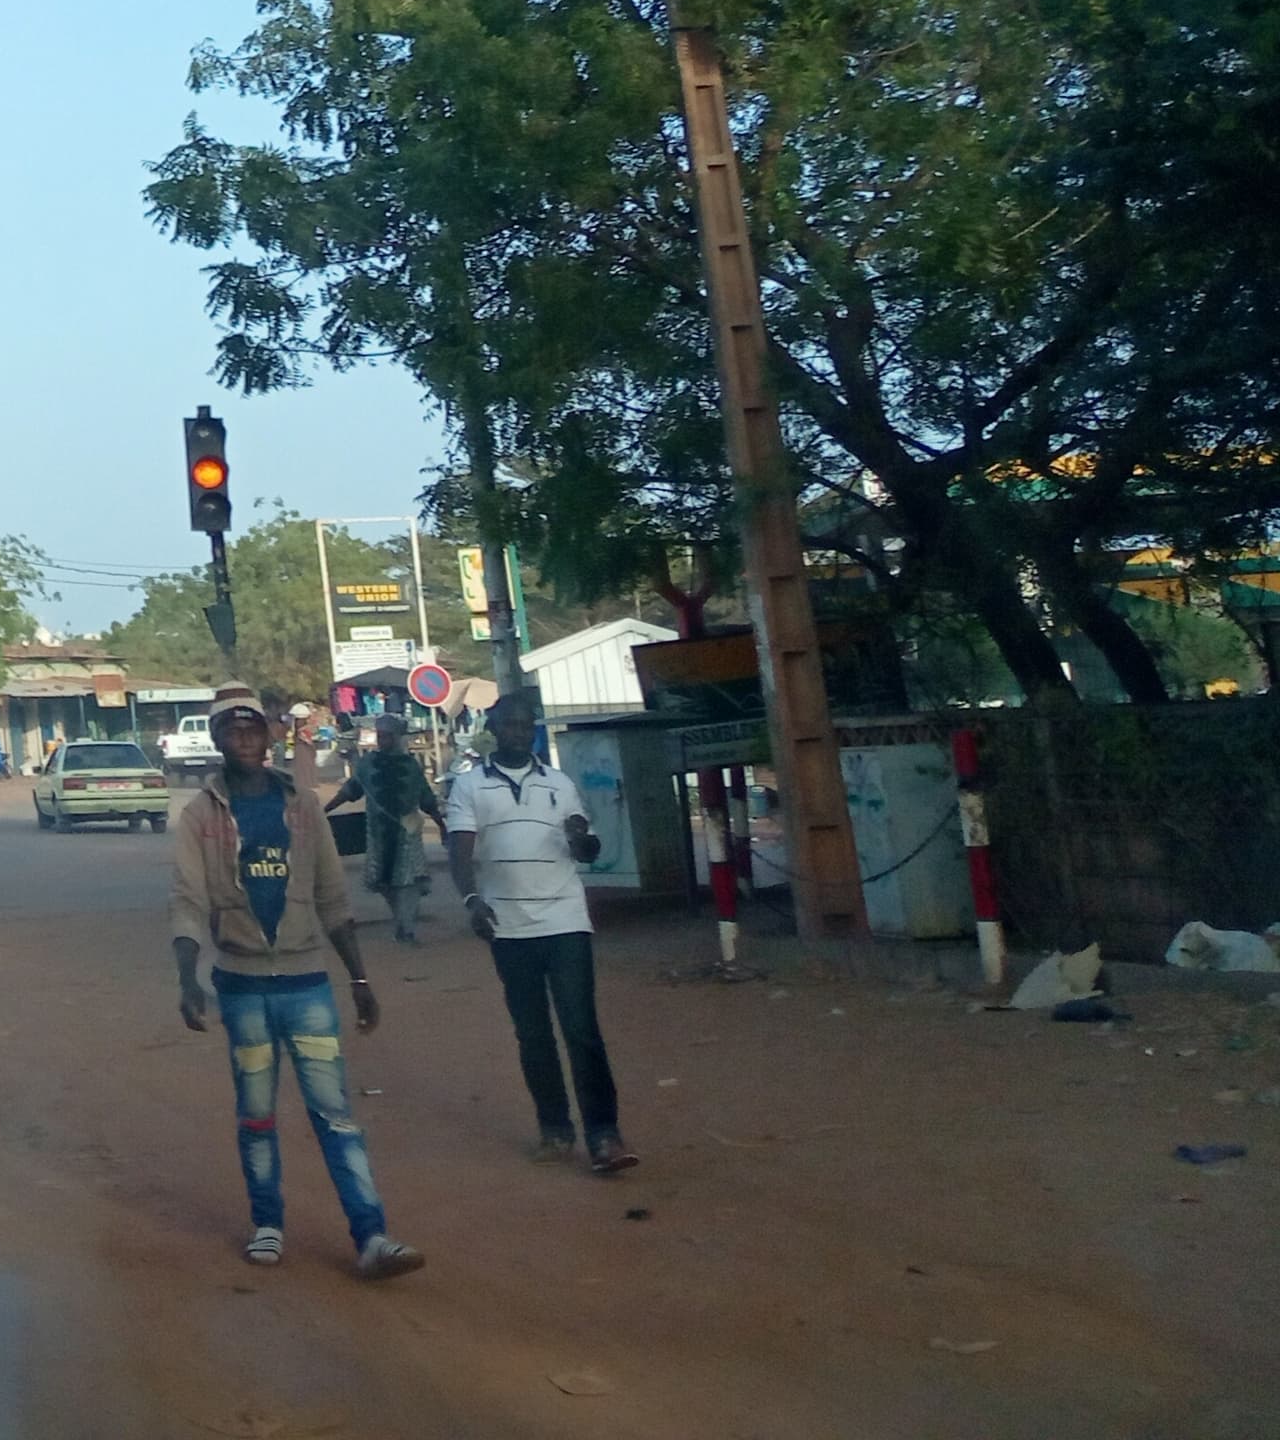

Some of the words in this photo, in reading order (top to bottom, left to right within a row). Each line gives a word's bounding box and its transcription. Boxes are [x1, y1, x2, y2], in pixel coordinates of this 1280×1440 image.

[336, 584, 399, 594] WESTERN
[356, 593, 400, 603] UNION
[177, 745, 212, 753] TOYOTA
